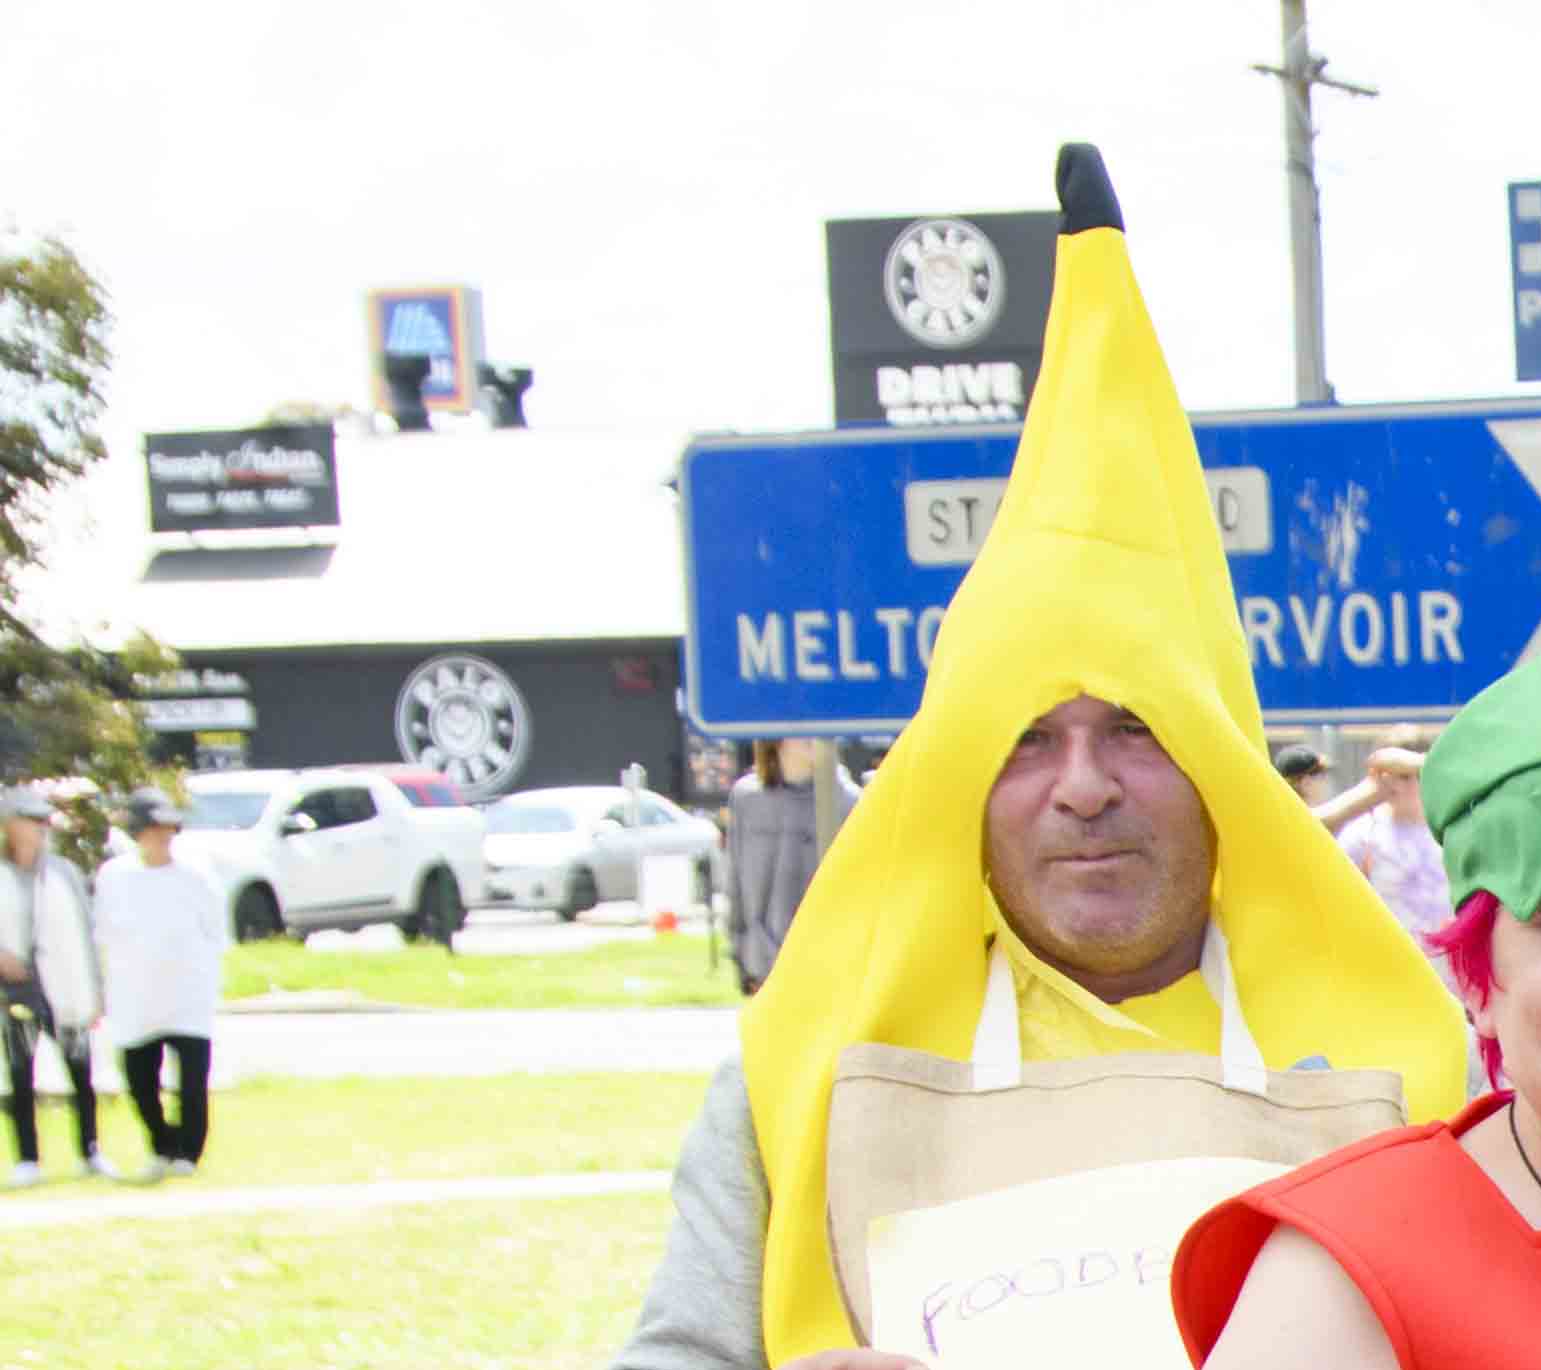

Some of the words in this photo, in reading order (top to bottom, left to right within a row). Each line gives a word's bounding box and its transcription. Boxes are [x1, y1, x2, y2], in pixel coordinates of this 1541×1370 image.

[875, 361, 1023, 407] DRIVE
[736, 607, 950, 682] MELTO
[1246, 590, 1465, 668] RVOIR
[920, 1246, 1171, 1358] FOODB
